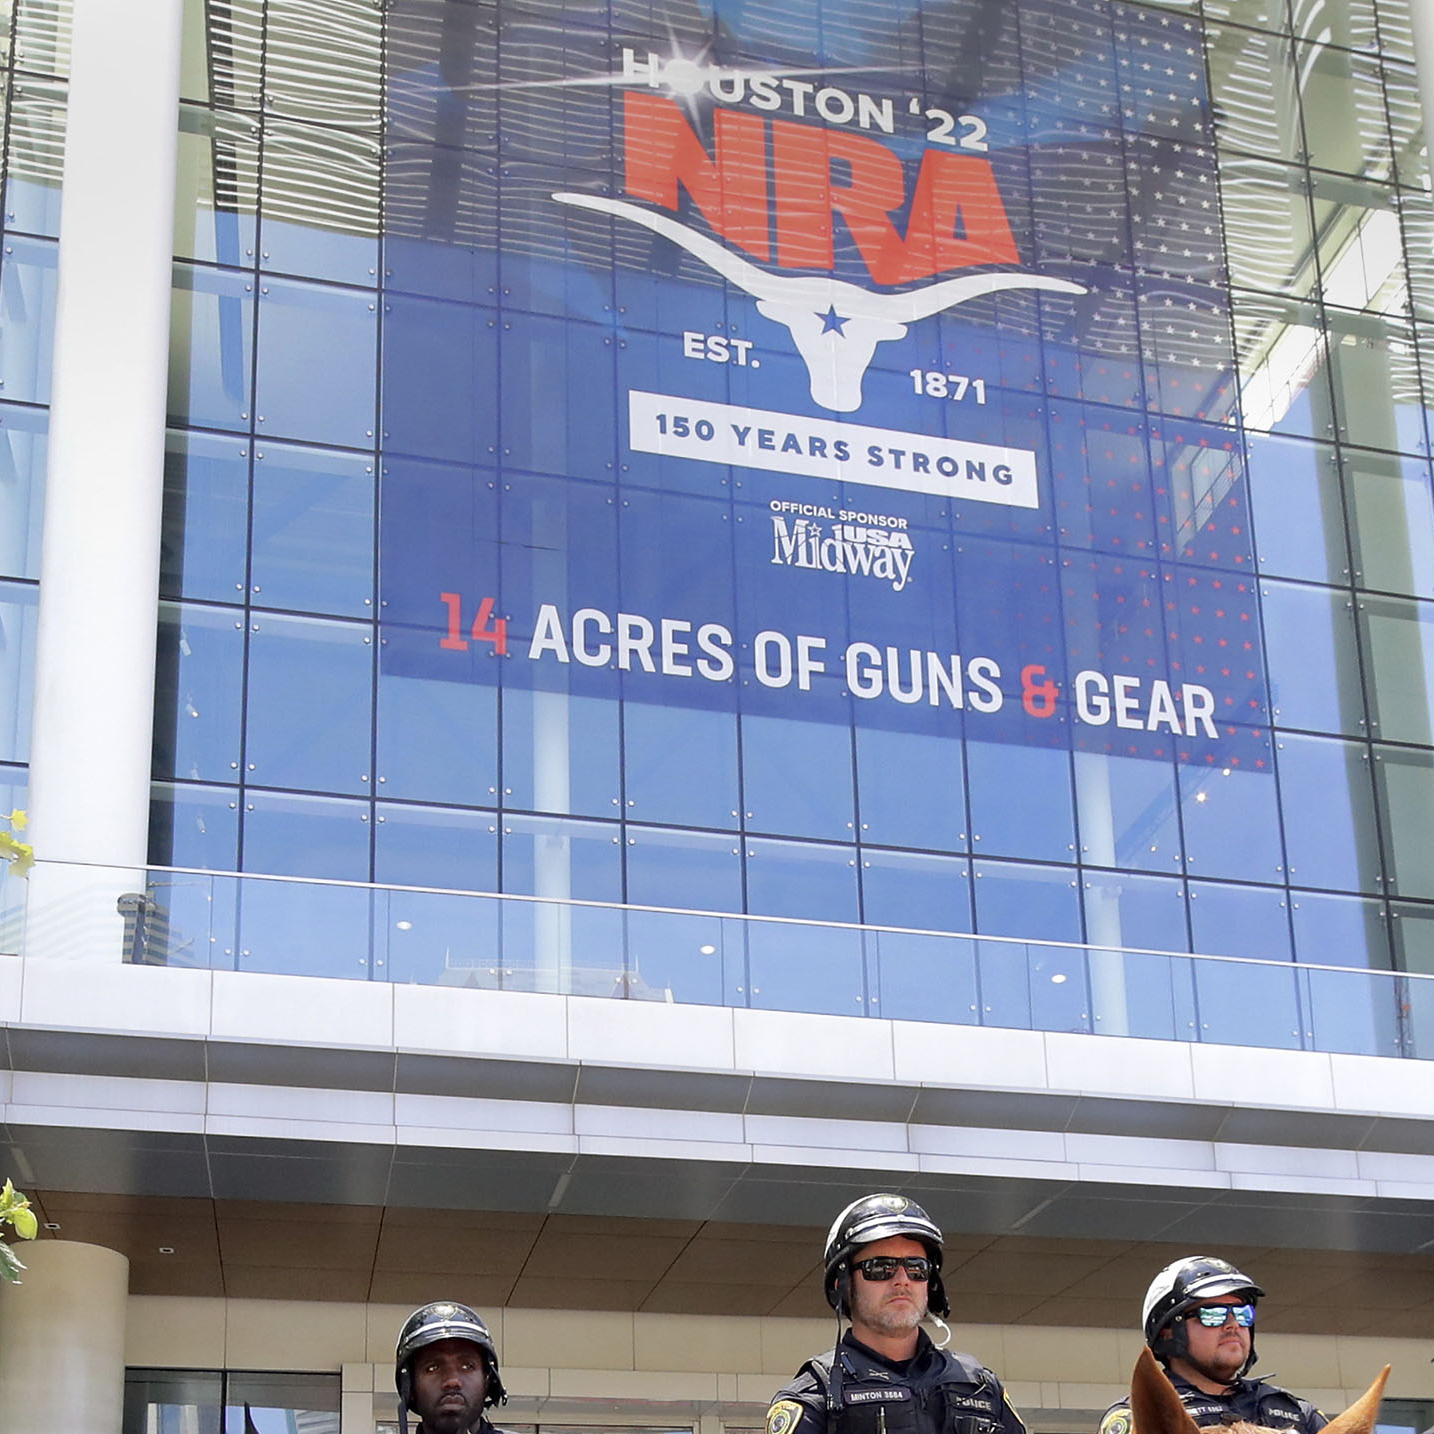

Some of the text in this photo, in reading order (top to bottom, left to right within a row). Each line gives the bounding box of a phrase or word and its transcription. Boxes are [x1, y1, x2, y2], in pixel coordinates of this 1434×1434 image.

[622, 48, 895, 133] HUSTON
[624, 91, 1021, 285] NRA
[682, 331, 760, 368] EST.
[910, 369, 986, 404] 1871
[656, 413, 1014, 485] 150 YEARS STRONG
[770, 500, 908, 529] OFFICIAL SPONSOR
[843, 525, 913, 549] USA
[770, 516, 915, 591] Midway
[440, 592, 1219, 739] 14 ACRES OF GUNS & GEAR
